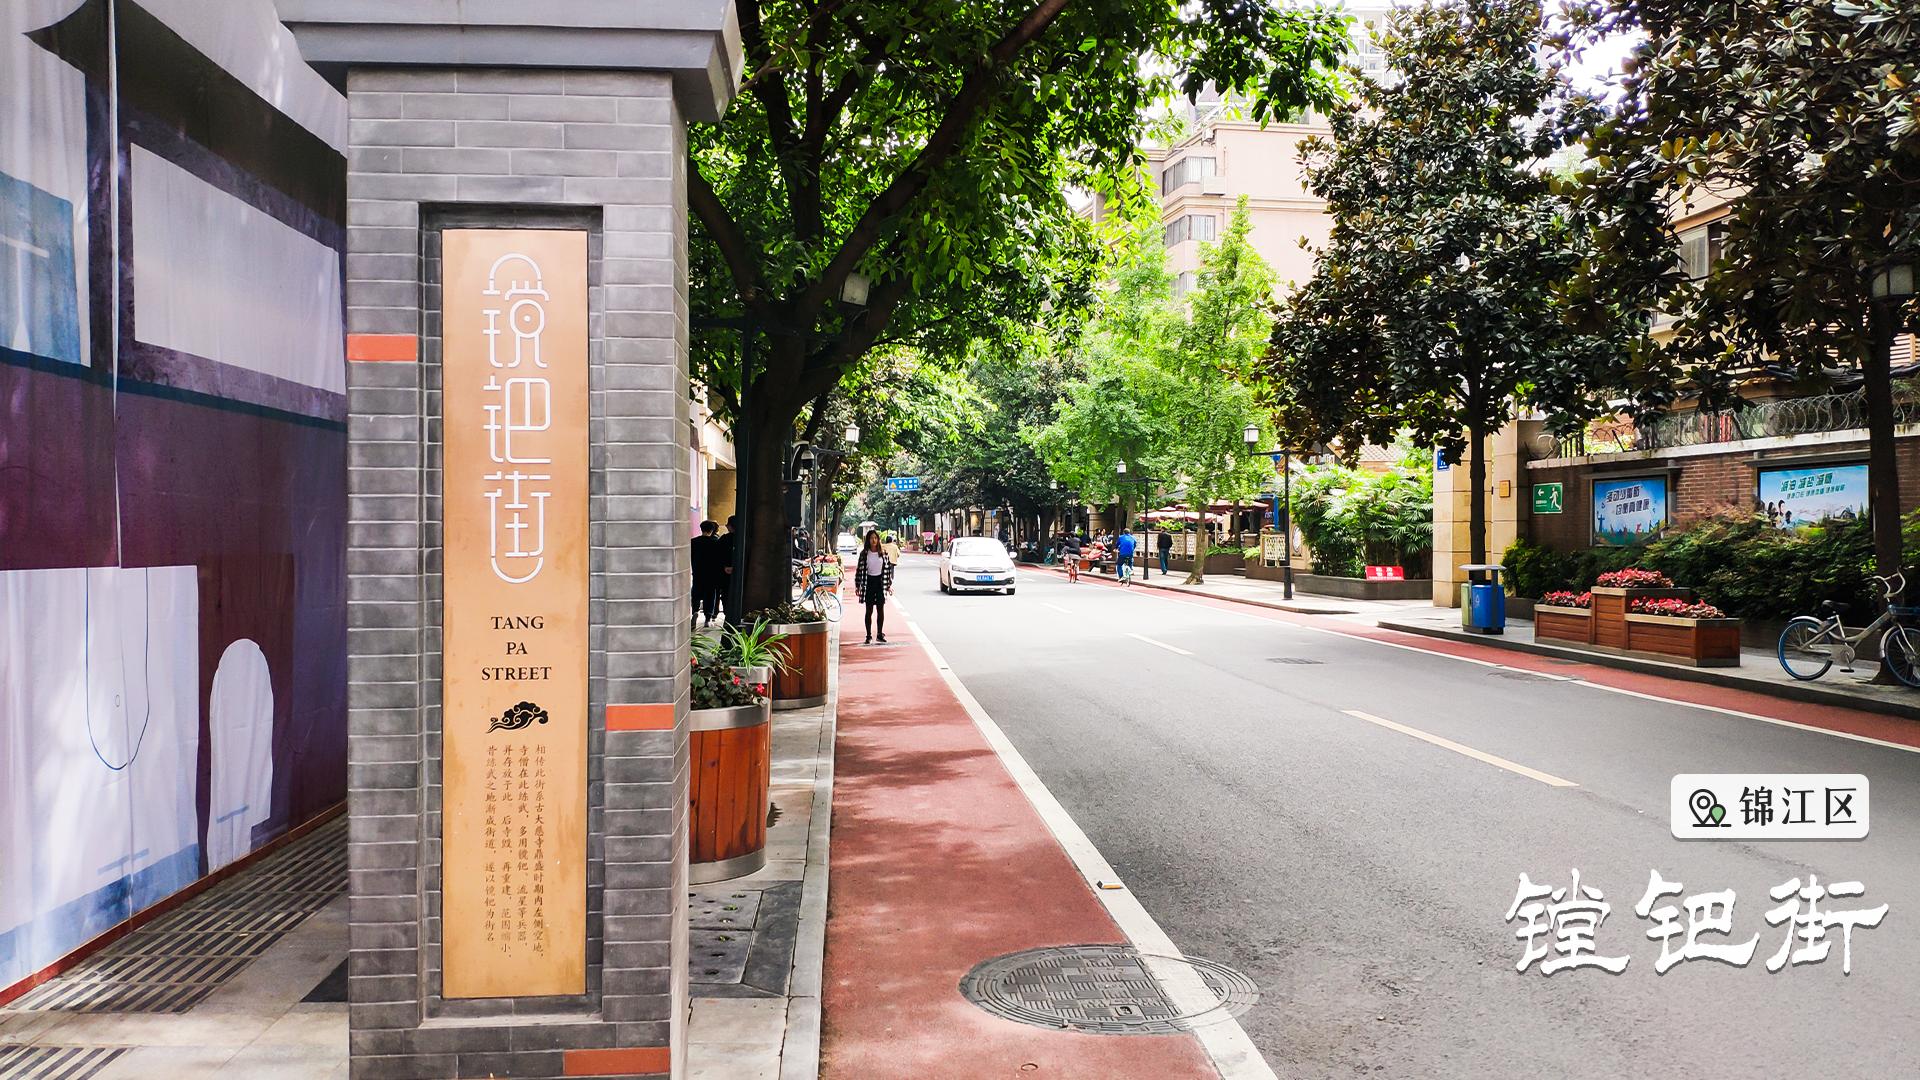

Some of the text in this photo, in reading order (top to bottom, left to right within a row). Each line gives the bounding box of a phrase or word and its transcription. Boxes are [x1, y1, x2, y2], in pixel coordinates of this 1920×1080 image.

[491, 616, 544, 631] TANG
[506, 642, 528, 656] PA
[481, 666, 552, 681] STREET
